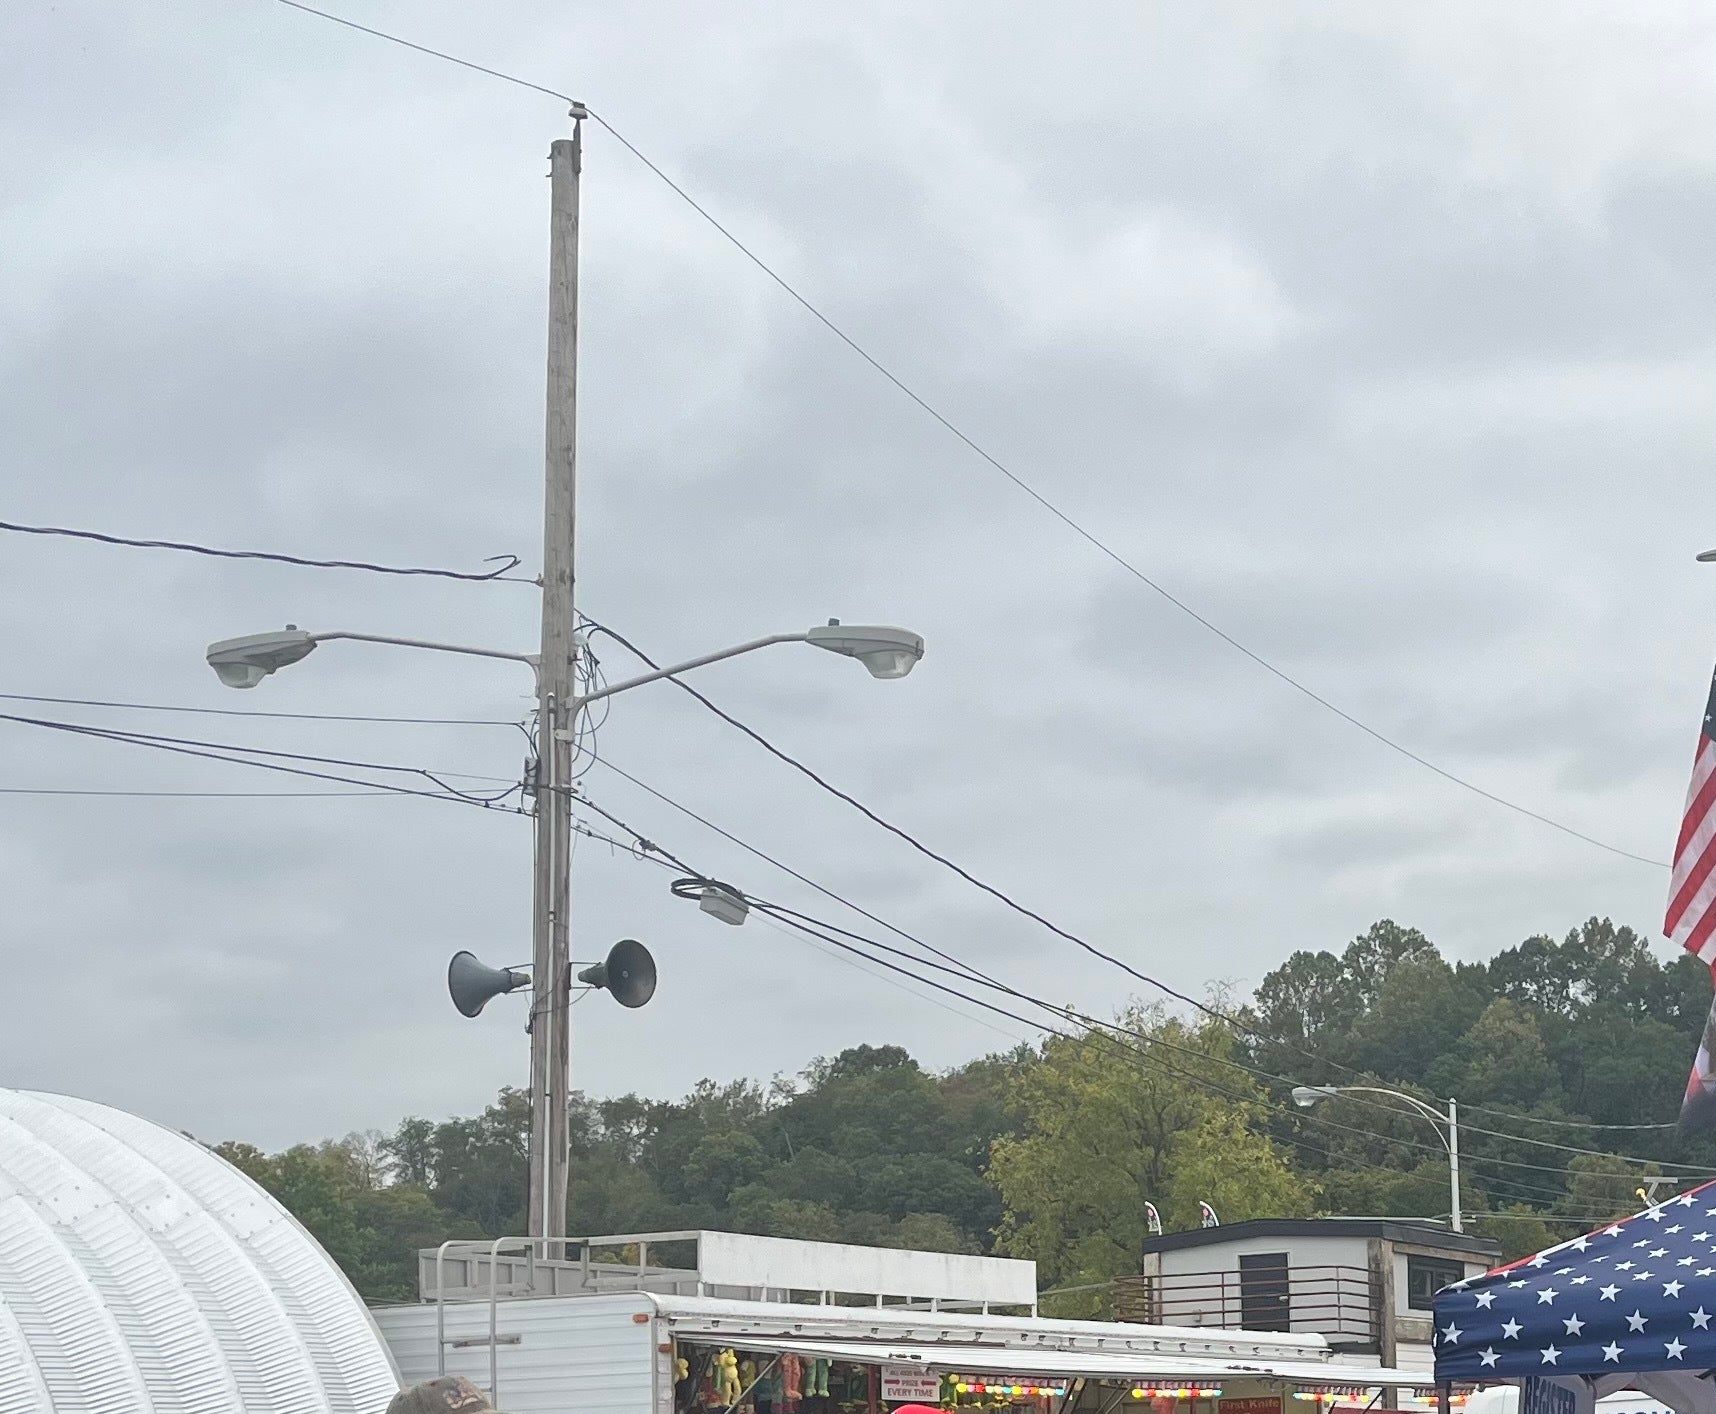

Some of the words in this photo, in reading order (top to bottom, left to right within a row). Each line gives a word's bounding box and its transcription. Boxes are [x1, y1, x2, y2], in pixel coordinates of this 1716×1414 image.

[887, 1388, 912, 1397] EVERY
[914, 1388, 934, 1398] TIME
[1221, 1400, 1245, 1410] First
[1249, 1399, 1280, 1409] Knife
